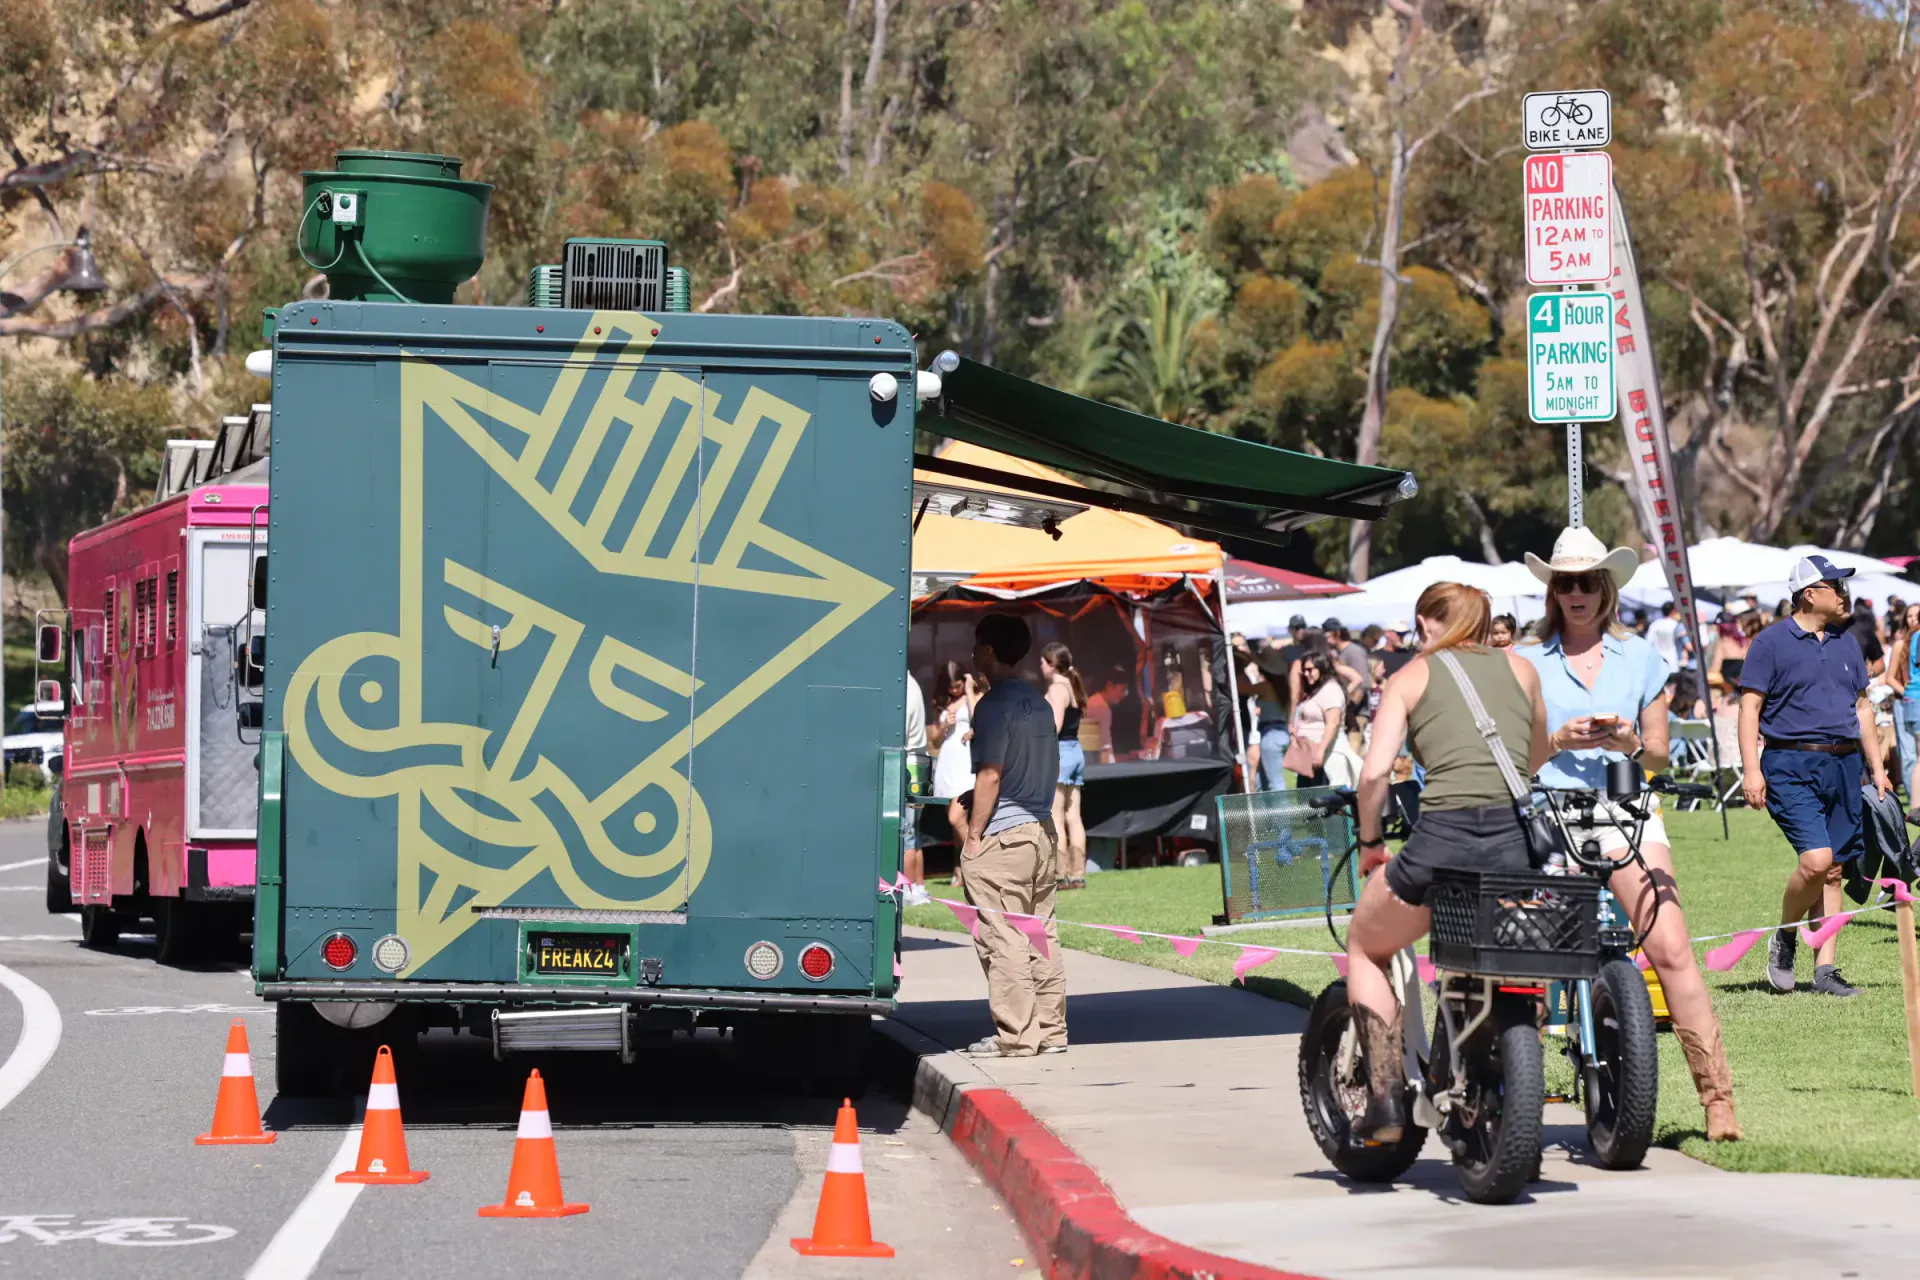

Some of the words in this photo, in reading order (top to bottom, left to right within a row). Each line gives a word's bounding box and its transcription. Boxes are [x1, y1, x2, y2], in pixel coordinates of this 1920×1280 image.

[1529, 130, 1561, 143] BIKE
[1566, 127, 1605, 141] LANE
[1530, 161, 1560, 189] NO
[1532, 195, 1604, 221] PARKING
[1535, 226, 1586, 246] 12AM
[1592, 228, 1604, 239] TO
[1549, 251, 1591, 270] 5AM
[1534, 300, 1554, 327] 4
[1564, 305, 1604, 325] HOUR
[1535, 341, 1608, 365] PARKING
[1546, 372, 1573, 391] 5AM
[1584, 375, 1599, 390] TO
[1546, 395, 1599, 411] MIDNIGHT
[221, 532, 266, 540] EMERGECY
[541, 947, 614, 968] FREAK24
